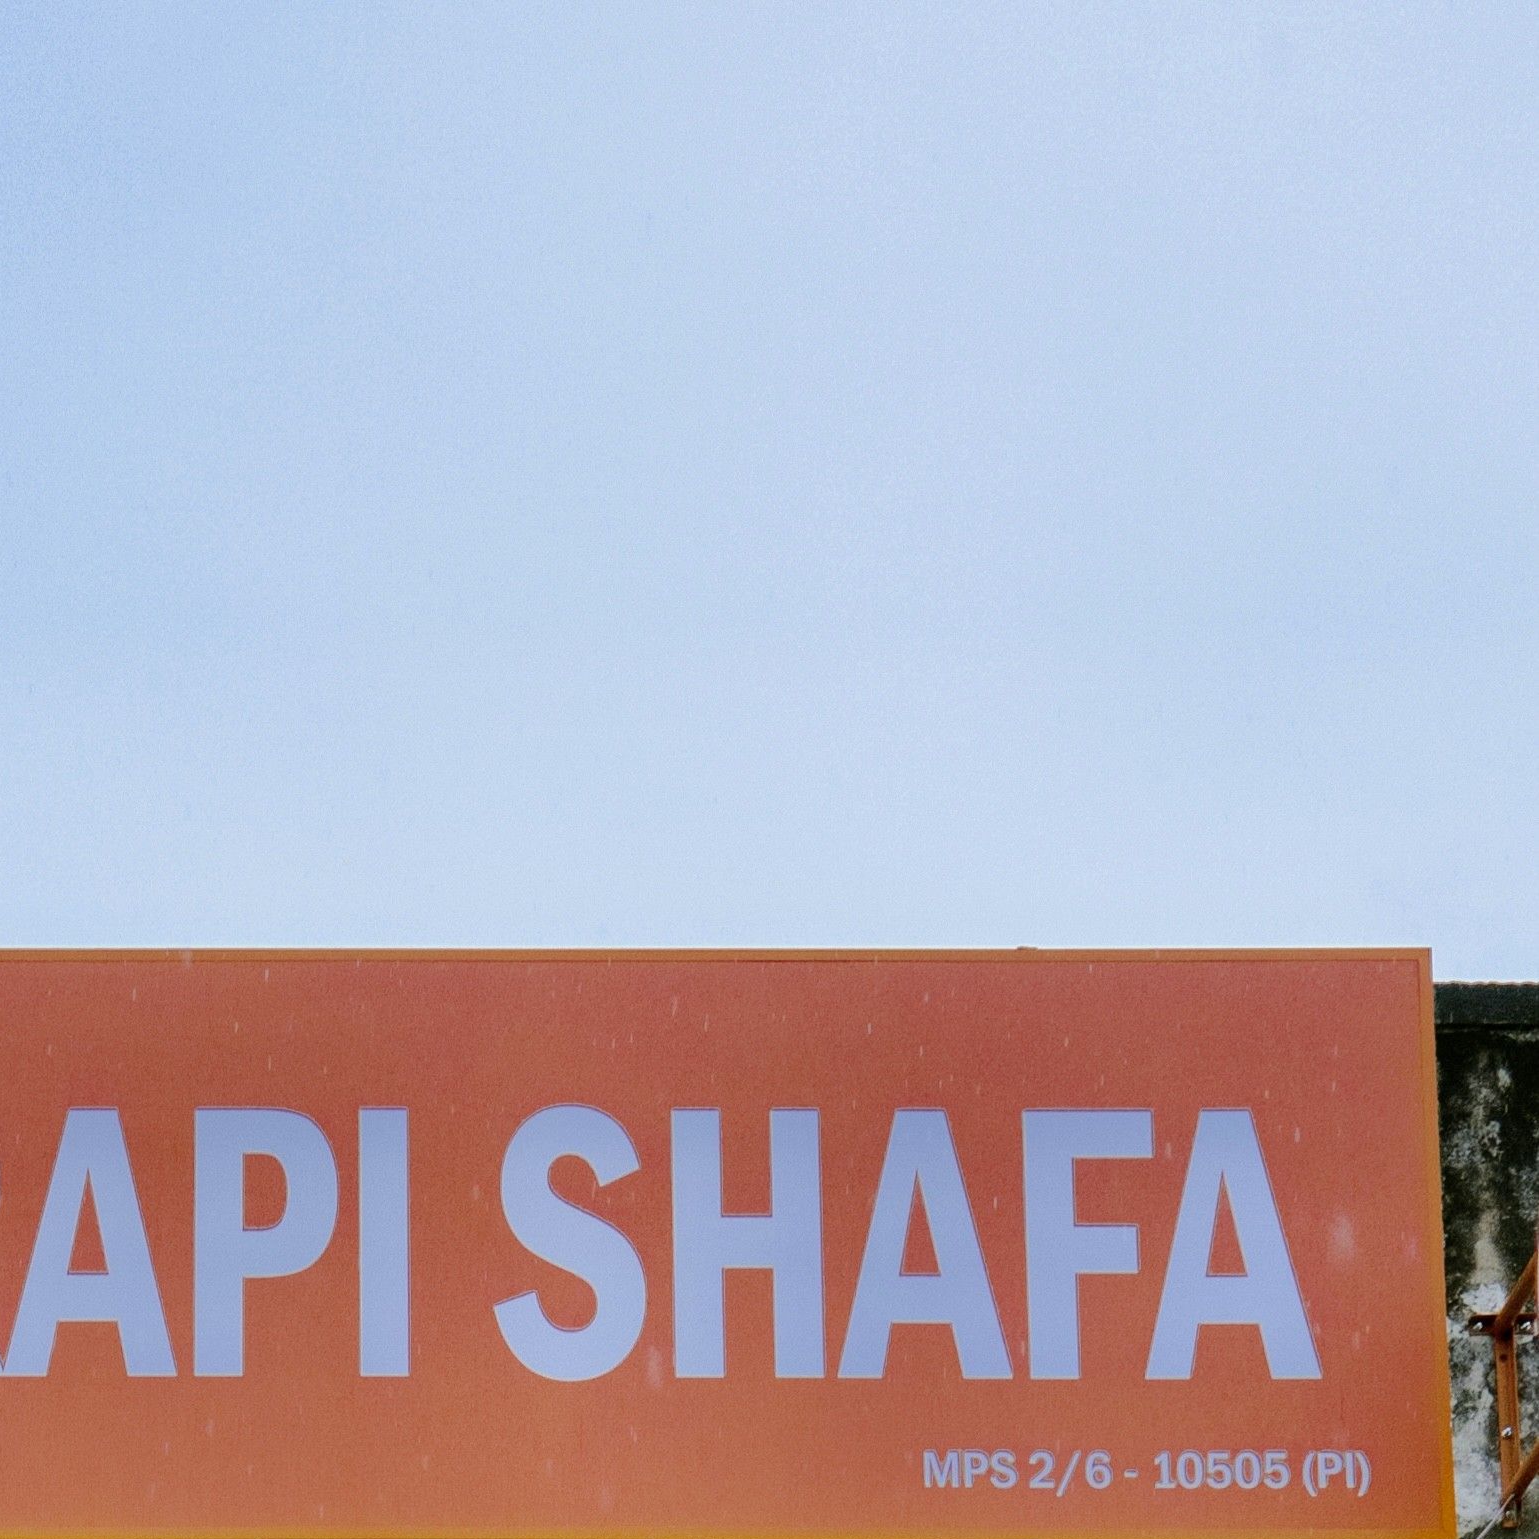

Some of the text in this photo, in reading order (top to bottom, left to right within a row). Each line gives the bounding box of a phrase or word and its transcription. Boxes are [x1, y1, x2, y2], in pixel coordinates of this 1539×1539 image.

[493, 1102, 1323, 1381] SHAFA
[921, 1449, 1019, 1490] MPS
[1028, 1449, 1114, 1497] 2/6
[1154, 1449, 1291, 1490] 10505
[1301, 1449, 1371, 1497] (PI)
